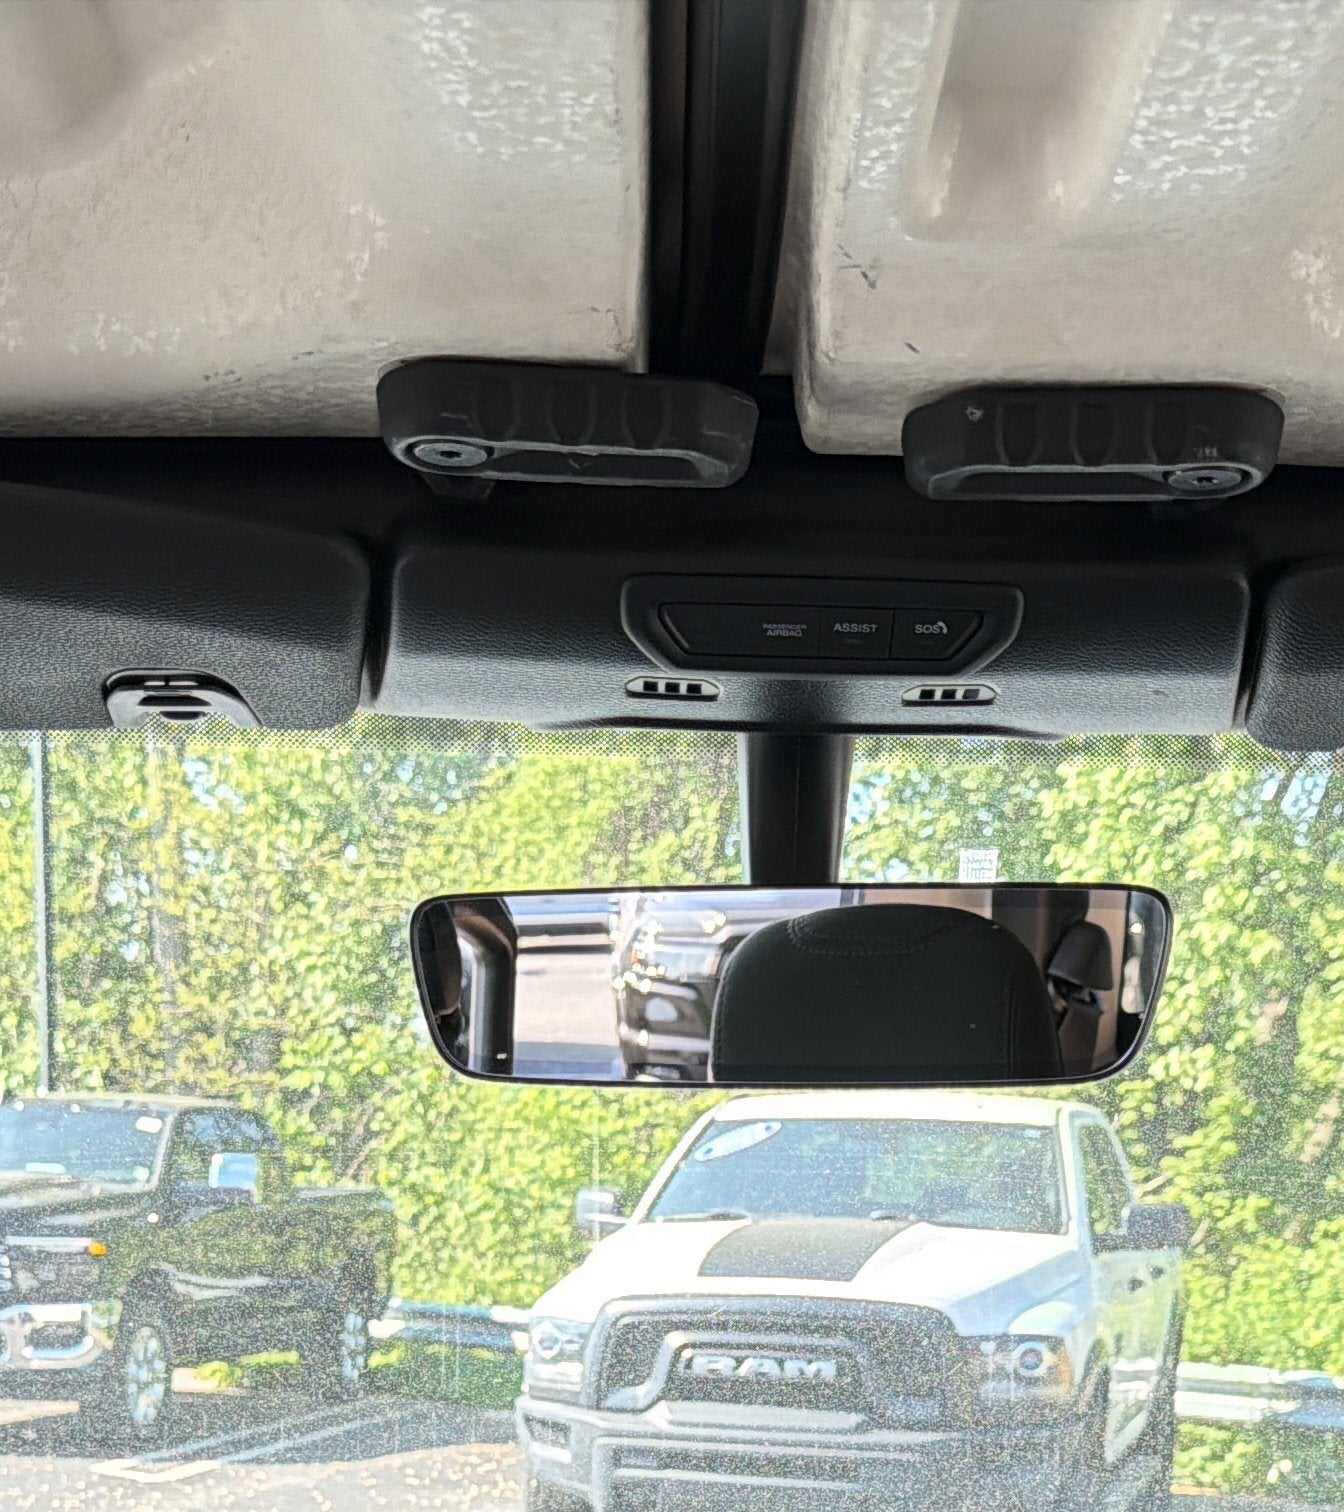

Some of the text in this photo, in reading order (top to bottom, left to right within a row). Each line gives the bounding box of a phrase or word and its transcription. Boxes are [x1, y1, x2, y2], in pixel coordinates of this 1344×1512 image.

[766, 628, 803, 637] AIRBAG
[833, 622, 878, 633] ASSIST
[914, 623, 940, 634] SOS
[691, 1355, 837, 1378] RAM
